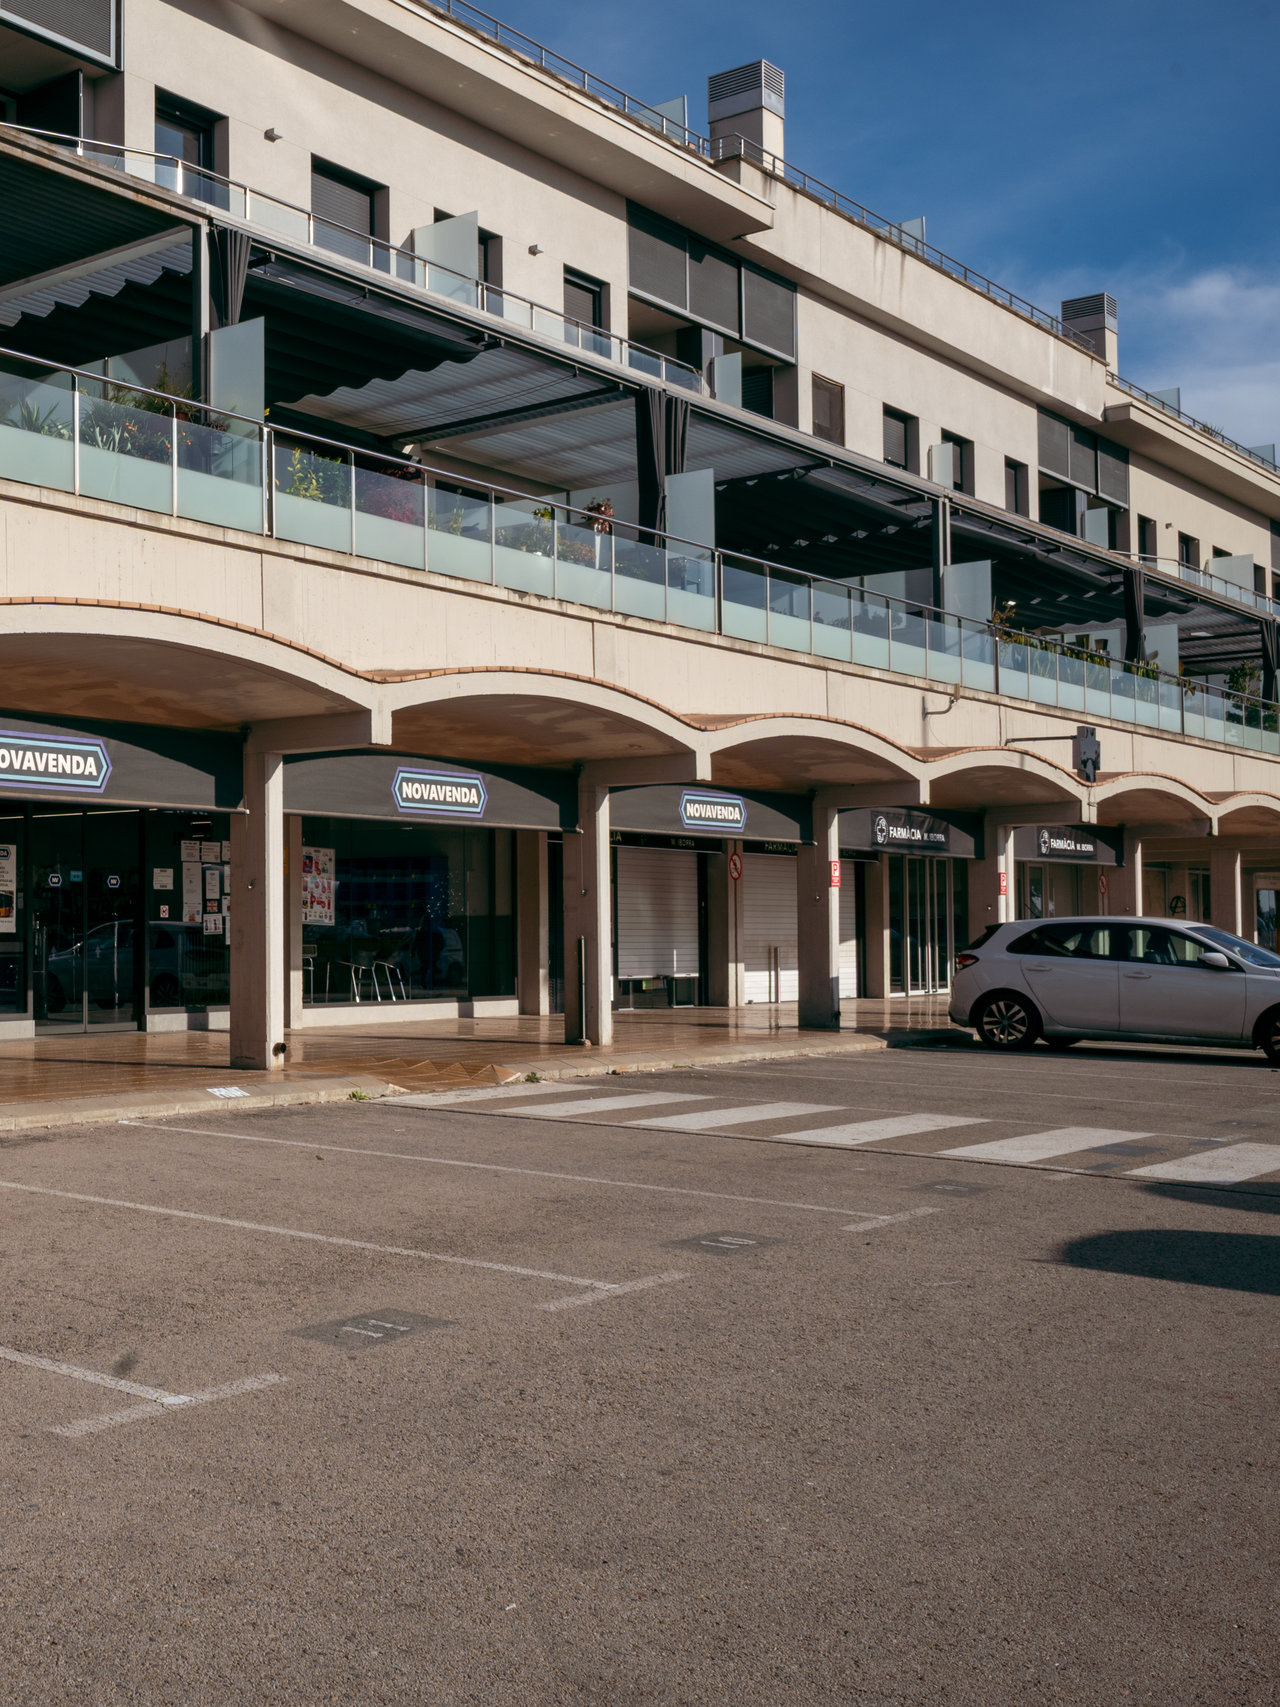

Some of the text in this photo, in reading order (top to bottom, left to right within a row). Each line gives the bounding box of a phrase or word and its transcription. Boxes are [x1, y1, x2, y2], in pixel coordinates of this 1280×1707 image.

[401, 782, 478, 804] NOVAVENDA
[686, 803, 741, 820] NOVAVENDA
[832, 863, 838, 875] P
